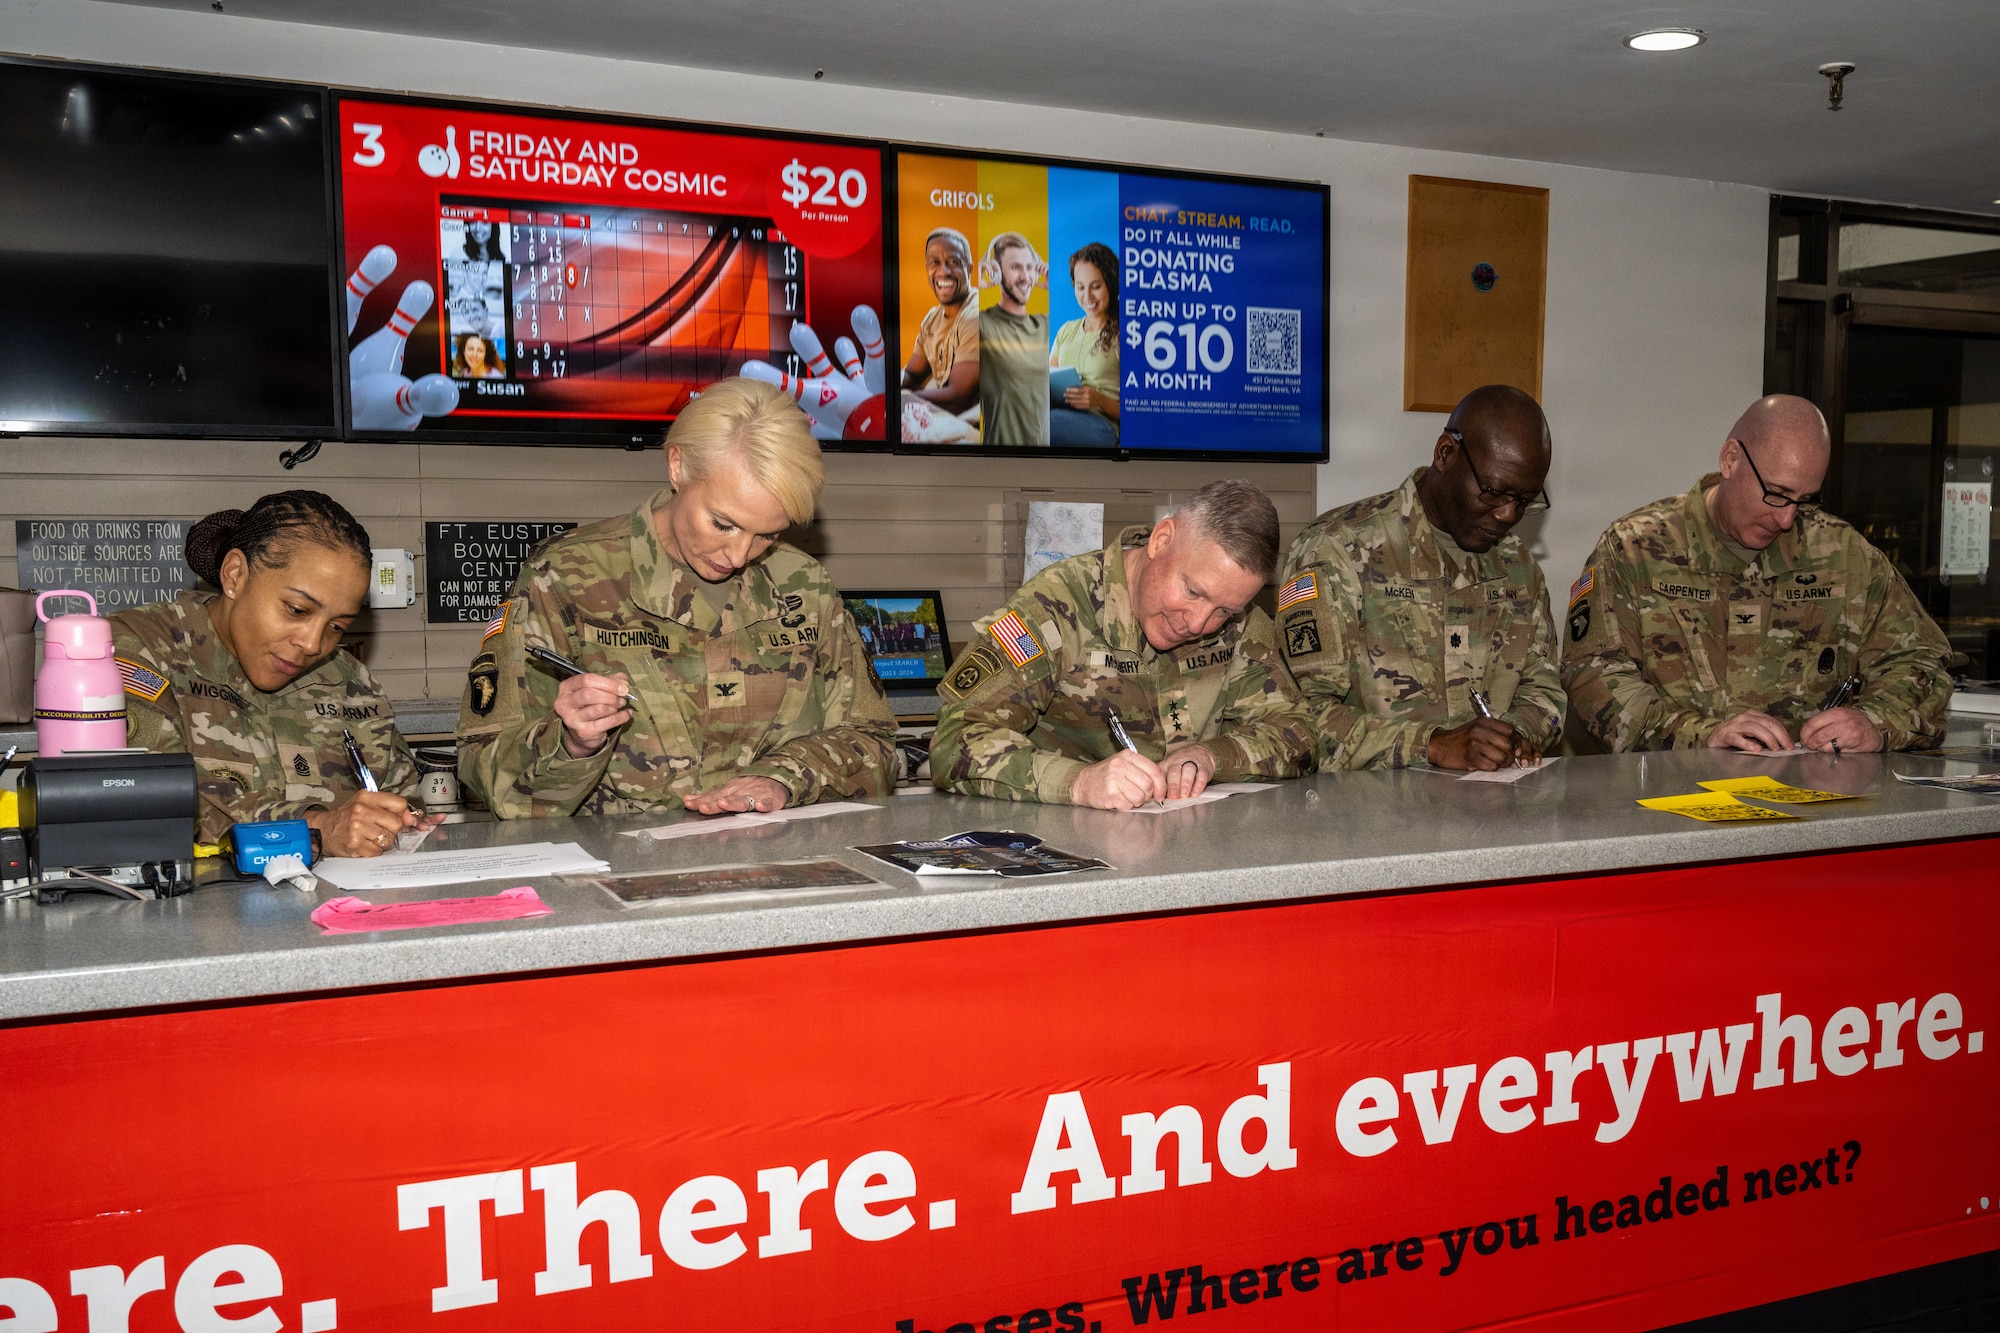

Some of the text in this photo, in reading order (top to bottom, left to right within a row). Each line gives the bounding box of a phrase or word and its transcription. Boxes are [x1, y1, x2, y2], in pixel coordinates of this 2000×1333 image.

[353, 122, 386, 167] 3
[470, 130, 638, 166] FRIDAY AND
[469, 155, 727, 197] SATURDAY COSMIC
[782, 158, 867, 208] $20
[930, 188, 994, 211] GRIFOLS
[441, 206, 489, 220] Game 1
[801, 210, 848, 223] Per Person
[1124, 206, 1296, 234] CHAT. STREAM. READ.
[526, 212, 533, 224] 1
[553, 214, 560, 226] 2
[579, 216, 586, 228] 3
[604, 219, 613, 230] 4
[632, 220, 639, 232] 5
[657, 222, 664, 234] 6
[682, 223, 689, 235] 7
[707, 225, 714, 237] 8
[732, 226, 739, 238] 9
[751, 228, 763, 240] 10
[1124, 227, 1241, 250] DO IT ALL WHILE
[513, 225, 520, 243] 5
[528, 227, 535, 244] 1
[540, 227, 547, 244] 8
[555, 228, 562, 245] 1
[783, 246, 797, 276] 15
[528, 244, 562, 264] 6 15
[1125, 247, 1235, 274] DONATING
[514, 264, 521, 282] 7
[529, 265, 536, 282] 1
[541, 266, 548, 283] 8
[556, 267, 563, 284] 1
[567, 267, 575, 285] 8
[784, 282, 798, 311] 17
[1125, 268, 1213, 293] PLASMA
[530, 283, 563, 301] 8 17
[515, 302, 523, 320] 8
[531, 304, 538, 321] 1
[557, 304, 564, 321] X
[584, 305, 591, 323] X
[1125, 299, 1237, 322] EARN UP TO
[531, 321, 538, 339] 9
[516, 341, 524, 359] 8
[543, 342, 551, 360] 9
[1125, 319, 1234, 373] $610
[532, 360, 566, 378] 8 17
[477, 380, 525, 396] Susan
[1125, 371, 1211, 391] A MONTH
[30, 523, 181, 539] FOOD OR DRINKS FROM
[439, 524, 474, 540] FT.
[32, 545, 182, 561] OUTSIDE SOURCES ARE
[33, 567, 183, 583] NOT PERMITTED IN
[439, 581, 460, 593] CAN
[464, 581, 483, 593] NOT
[488, 581, 500, 593] BE
[1659, 581, 1711, 601] CARPENTER
[1803, 587, 1833, 599] ARMY
[440, 595, 460, 607] FOR
[597, 629, 669, 650] HUTCHINSON
[769, 633, 795, 647] U.S.
[1186, 656, 1210, 670] U.S.
[314, 703, 341, 716] U.S.
[342, 704, 379, 720] ARMY
[103, 779, 135, 788] EPSON
[397, 1150, 957, 1313] There.
[1011, 1061, 1298, 1216] And
[1335, 992, 1984, 1158] everywhere.
[1121, 1255, 1320, 1326] Where
[1336, 1235, 1425, 1285] are
[1438, 1212, 1541, 1277] you
[1554, 1166, 1731, 1241] headed
[1743, 1139, 1862, 1204] next?
